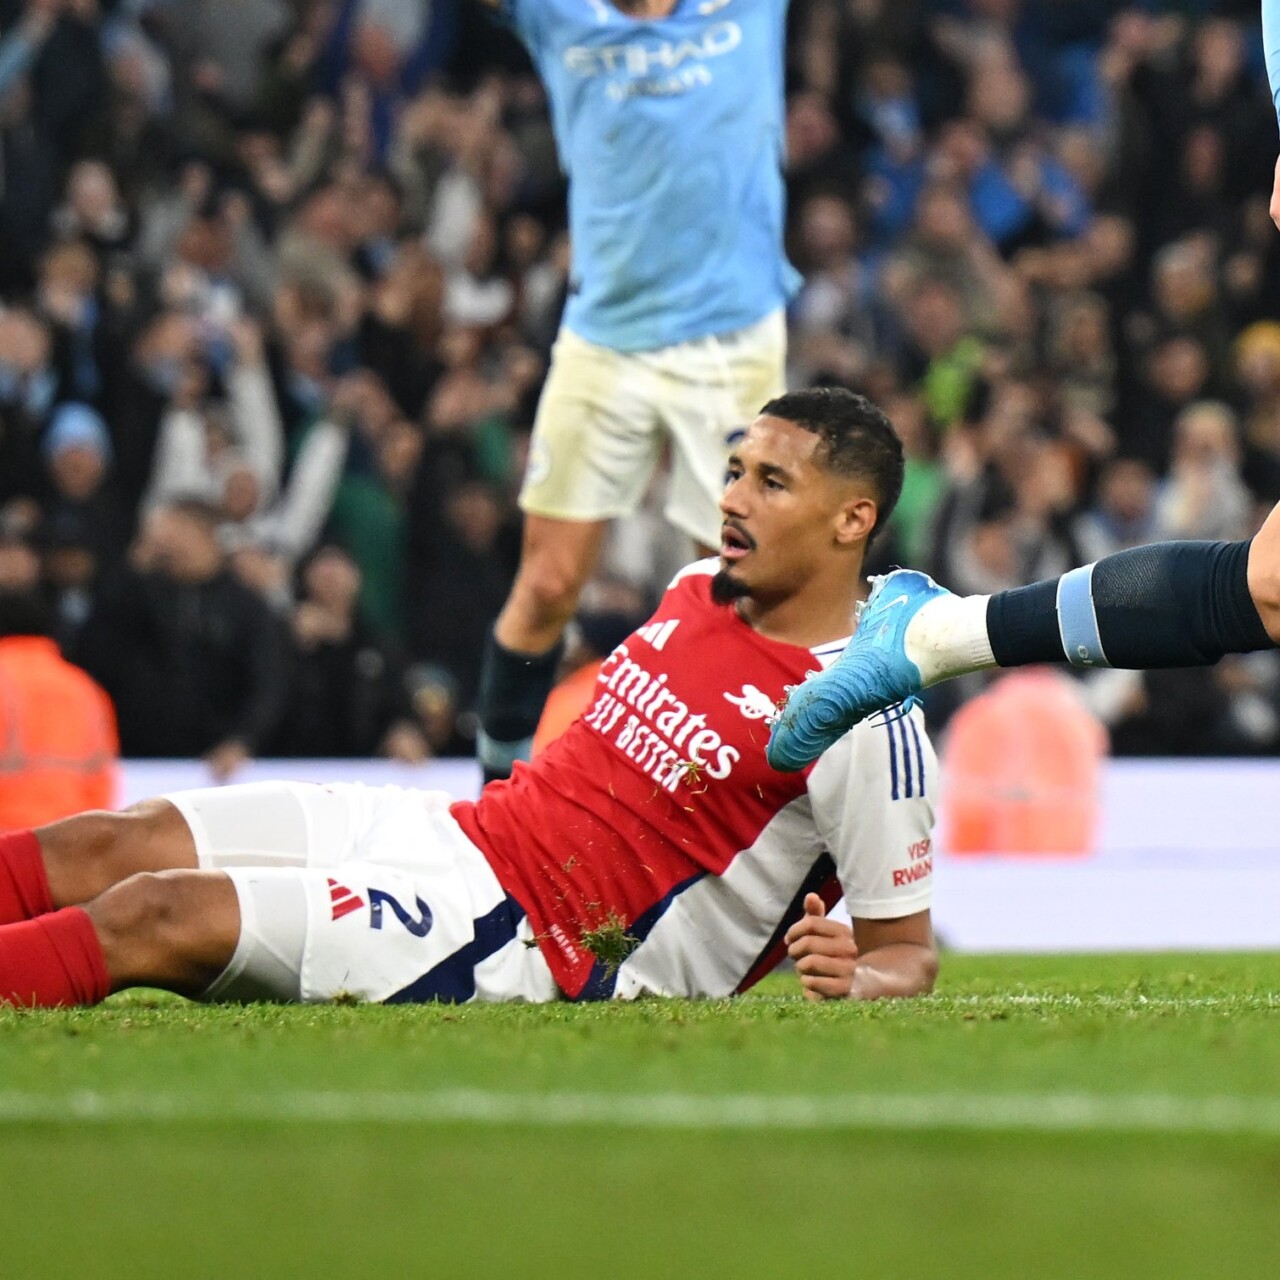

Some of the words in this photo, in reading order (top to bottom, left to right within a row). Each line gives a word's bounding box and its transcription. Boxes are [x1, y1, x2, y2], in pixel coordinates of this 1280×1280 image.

[596, 643, 741, 781] Emirates
[614, 714, 689, 794] BETTER
[366, 886, 434, 939] 2
